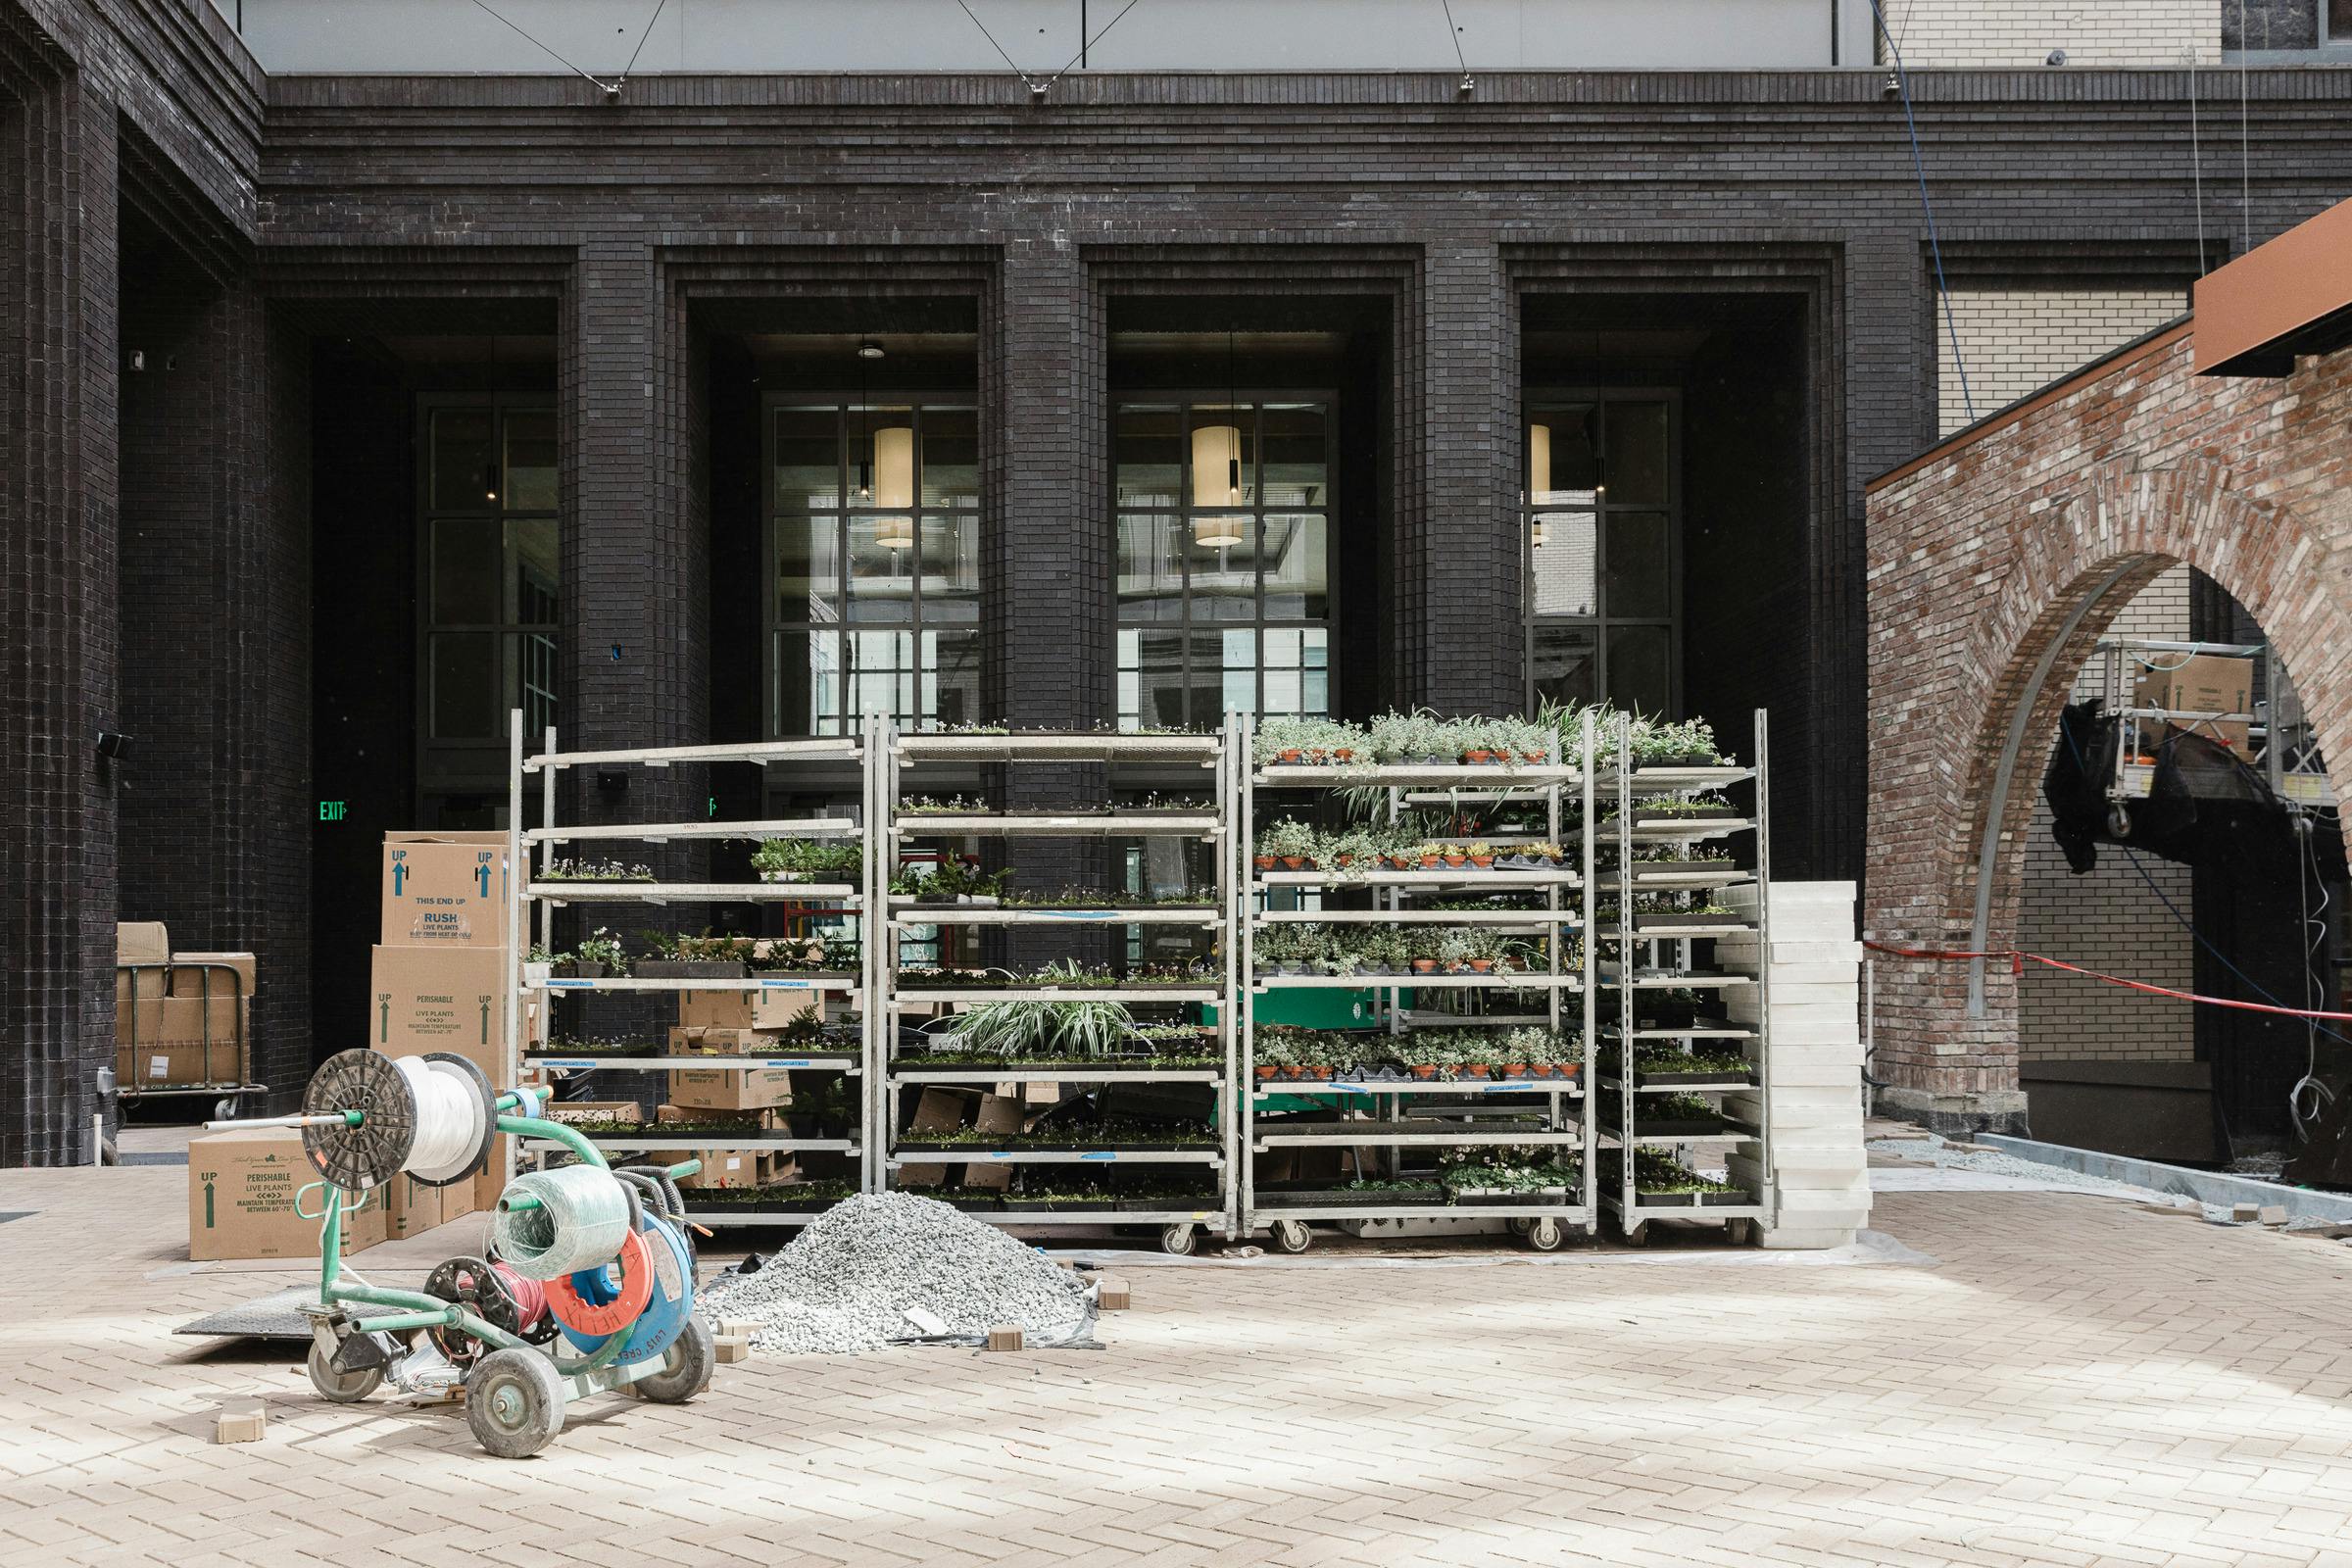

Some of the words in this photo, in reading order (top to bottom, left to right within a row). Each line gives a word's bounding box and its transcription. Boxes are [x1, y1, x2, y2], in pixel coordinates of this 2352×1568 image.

[319, 801, 344, 820] EXIT
[392, 851, 407, 860] UP
[478, 852, 492, 862] UP
[424, 913, 458, 923] RUSH
[201, 1172, 218, 1181] UP
[247, 1173, 291, 1182] PERISHABLE
